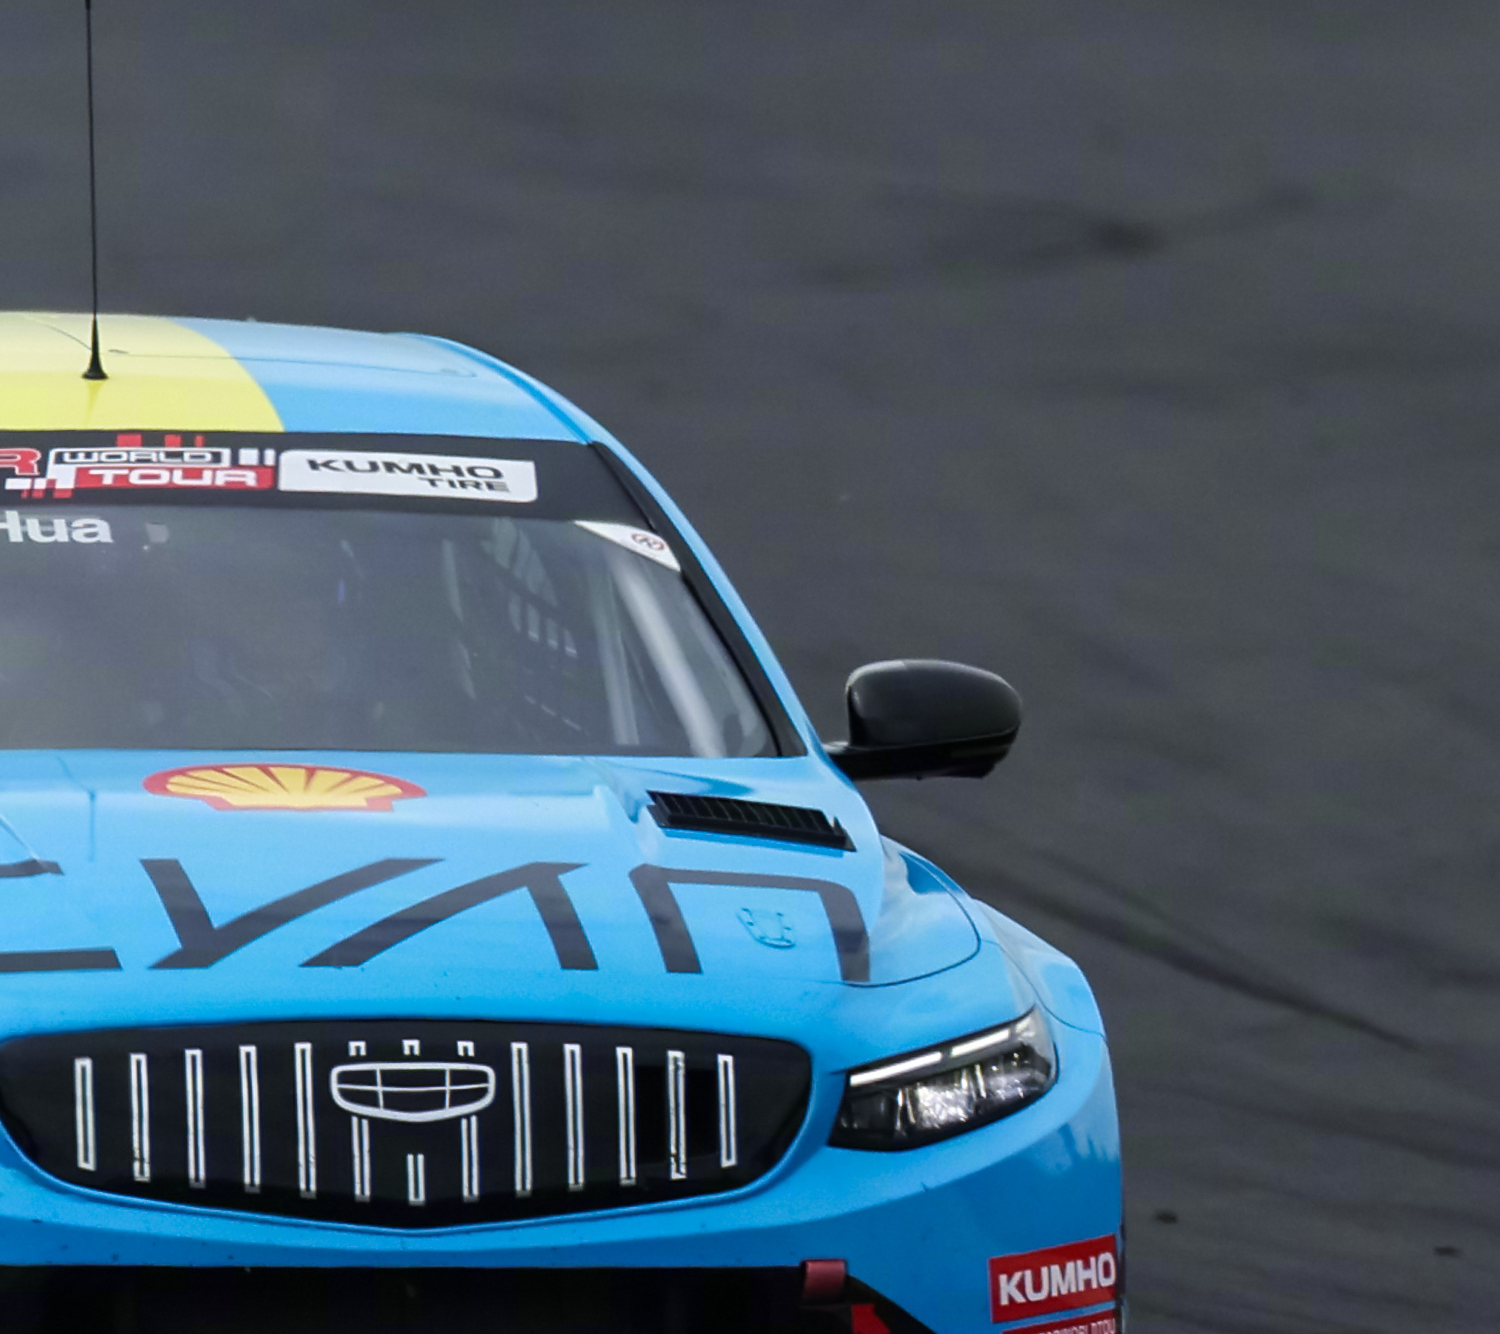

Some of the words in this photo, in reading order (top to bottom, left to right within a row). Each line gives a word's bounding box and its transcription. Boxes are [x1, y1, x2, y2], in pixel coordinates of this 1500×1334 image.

[62, 451, 213, 464] WORLD
[88, 468, 261, 488] TOUR
[306, 458, 505, 479] KUMHO
[417, 477, 511, 494] TIRE
[999, 1251, 1116, 1306] KUMHO
